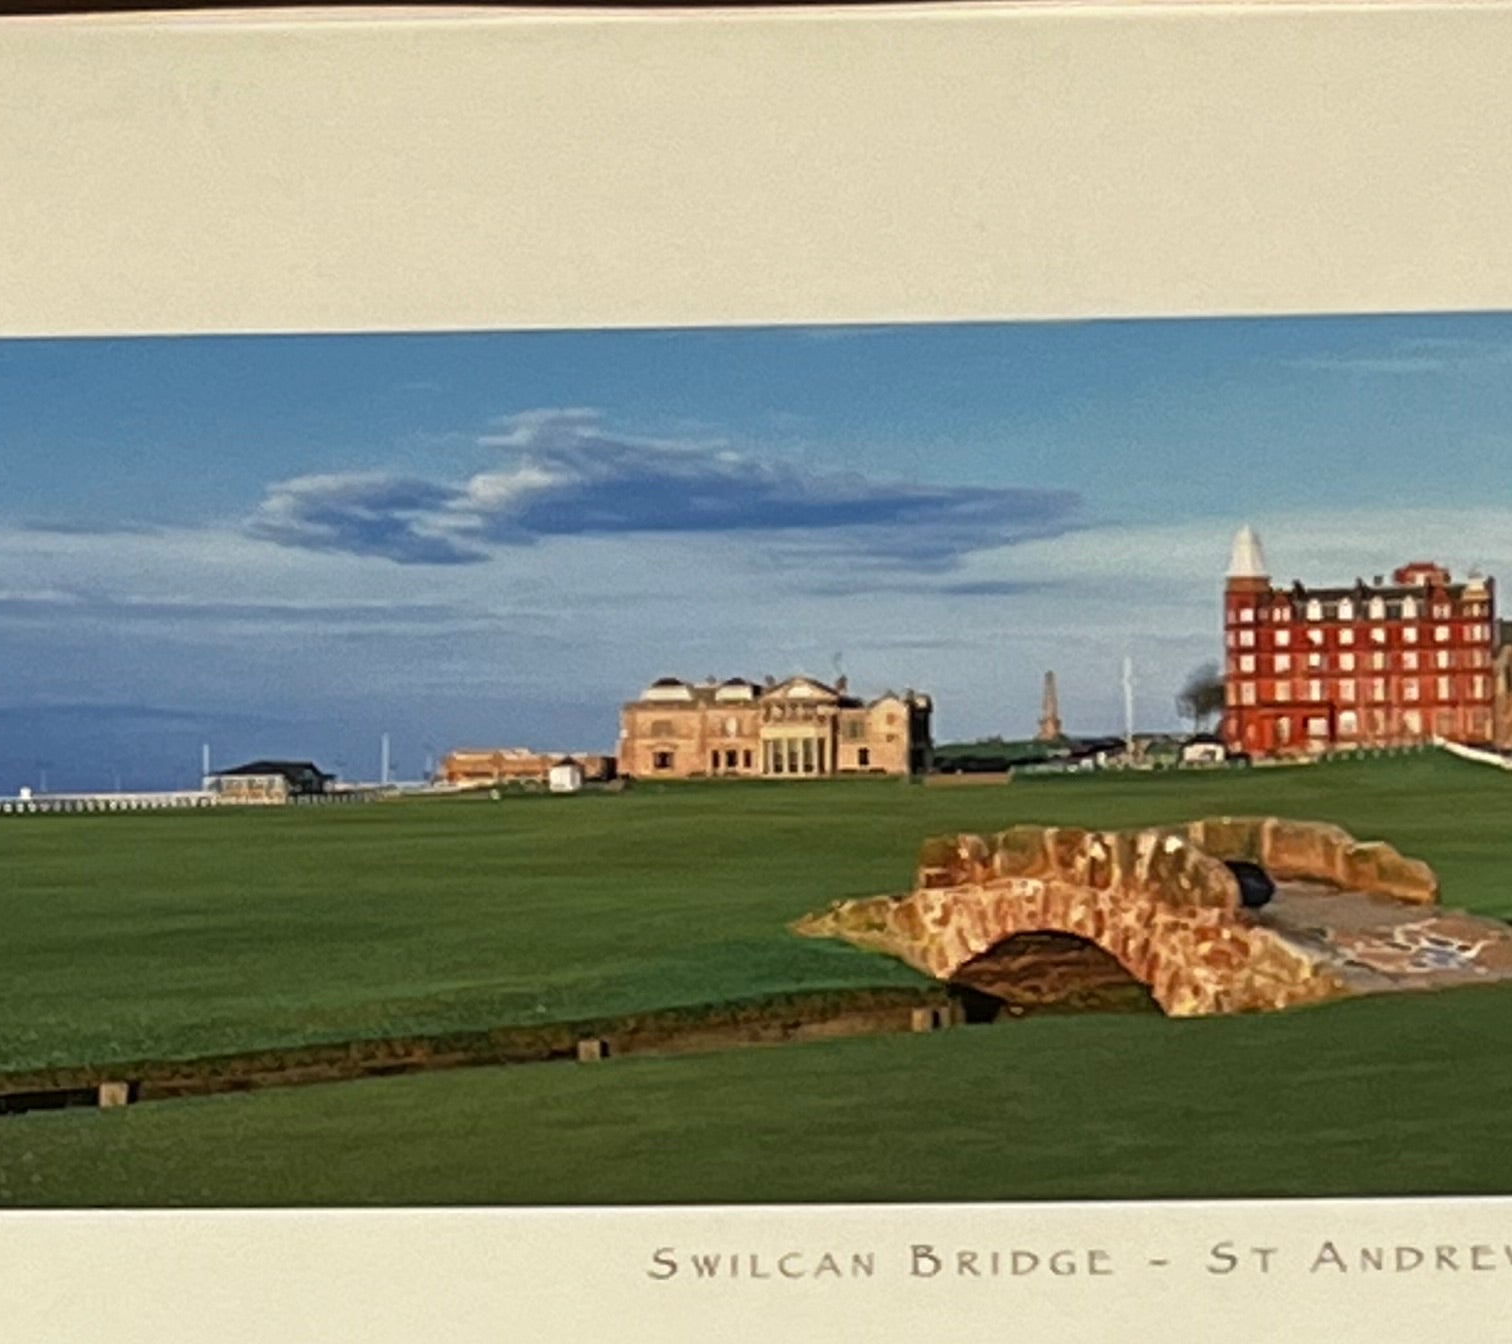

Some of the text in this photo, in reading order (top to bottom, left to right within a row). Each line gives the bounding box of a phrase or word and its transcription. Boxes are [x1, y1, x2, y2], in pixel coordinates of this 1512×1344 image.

[647, 1247, 876, 1279] SWILCAN
[909, 1244, 1116, 1277] BRIDGE
[1206, 1242, 1278, 1275] ST
[1310, 1240, 1512, 1274] ANDRE
